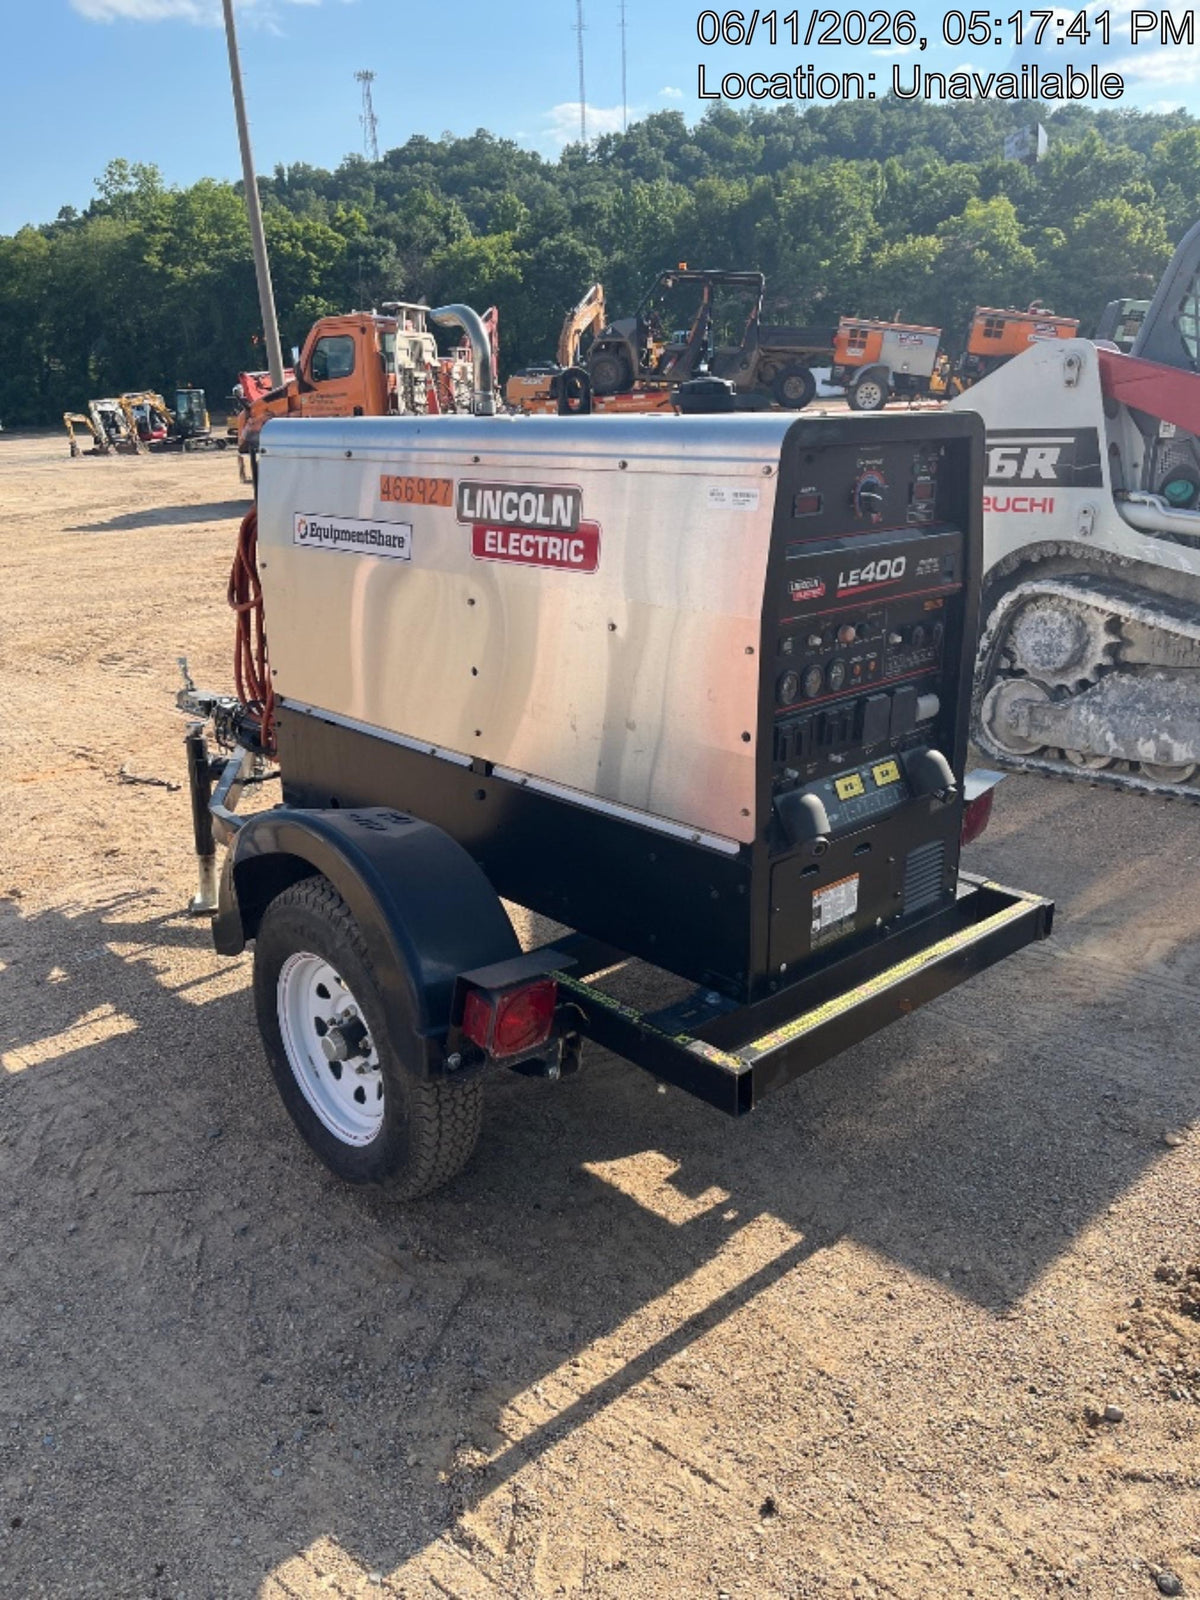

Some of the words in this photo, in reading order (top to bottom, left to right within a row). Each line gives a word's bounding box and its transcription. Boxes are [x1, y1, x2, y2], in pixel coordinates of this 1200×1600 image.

[381, 477, 451, 505] 466927
[462, 487, 575, 527] LINCOLN
[308, 521, 406, 550] EquipmentShare
[484, 530, 586, 563] ELECTRIC
[837, 556, 907, 589] LE400
